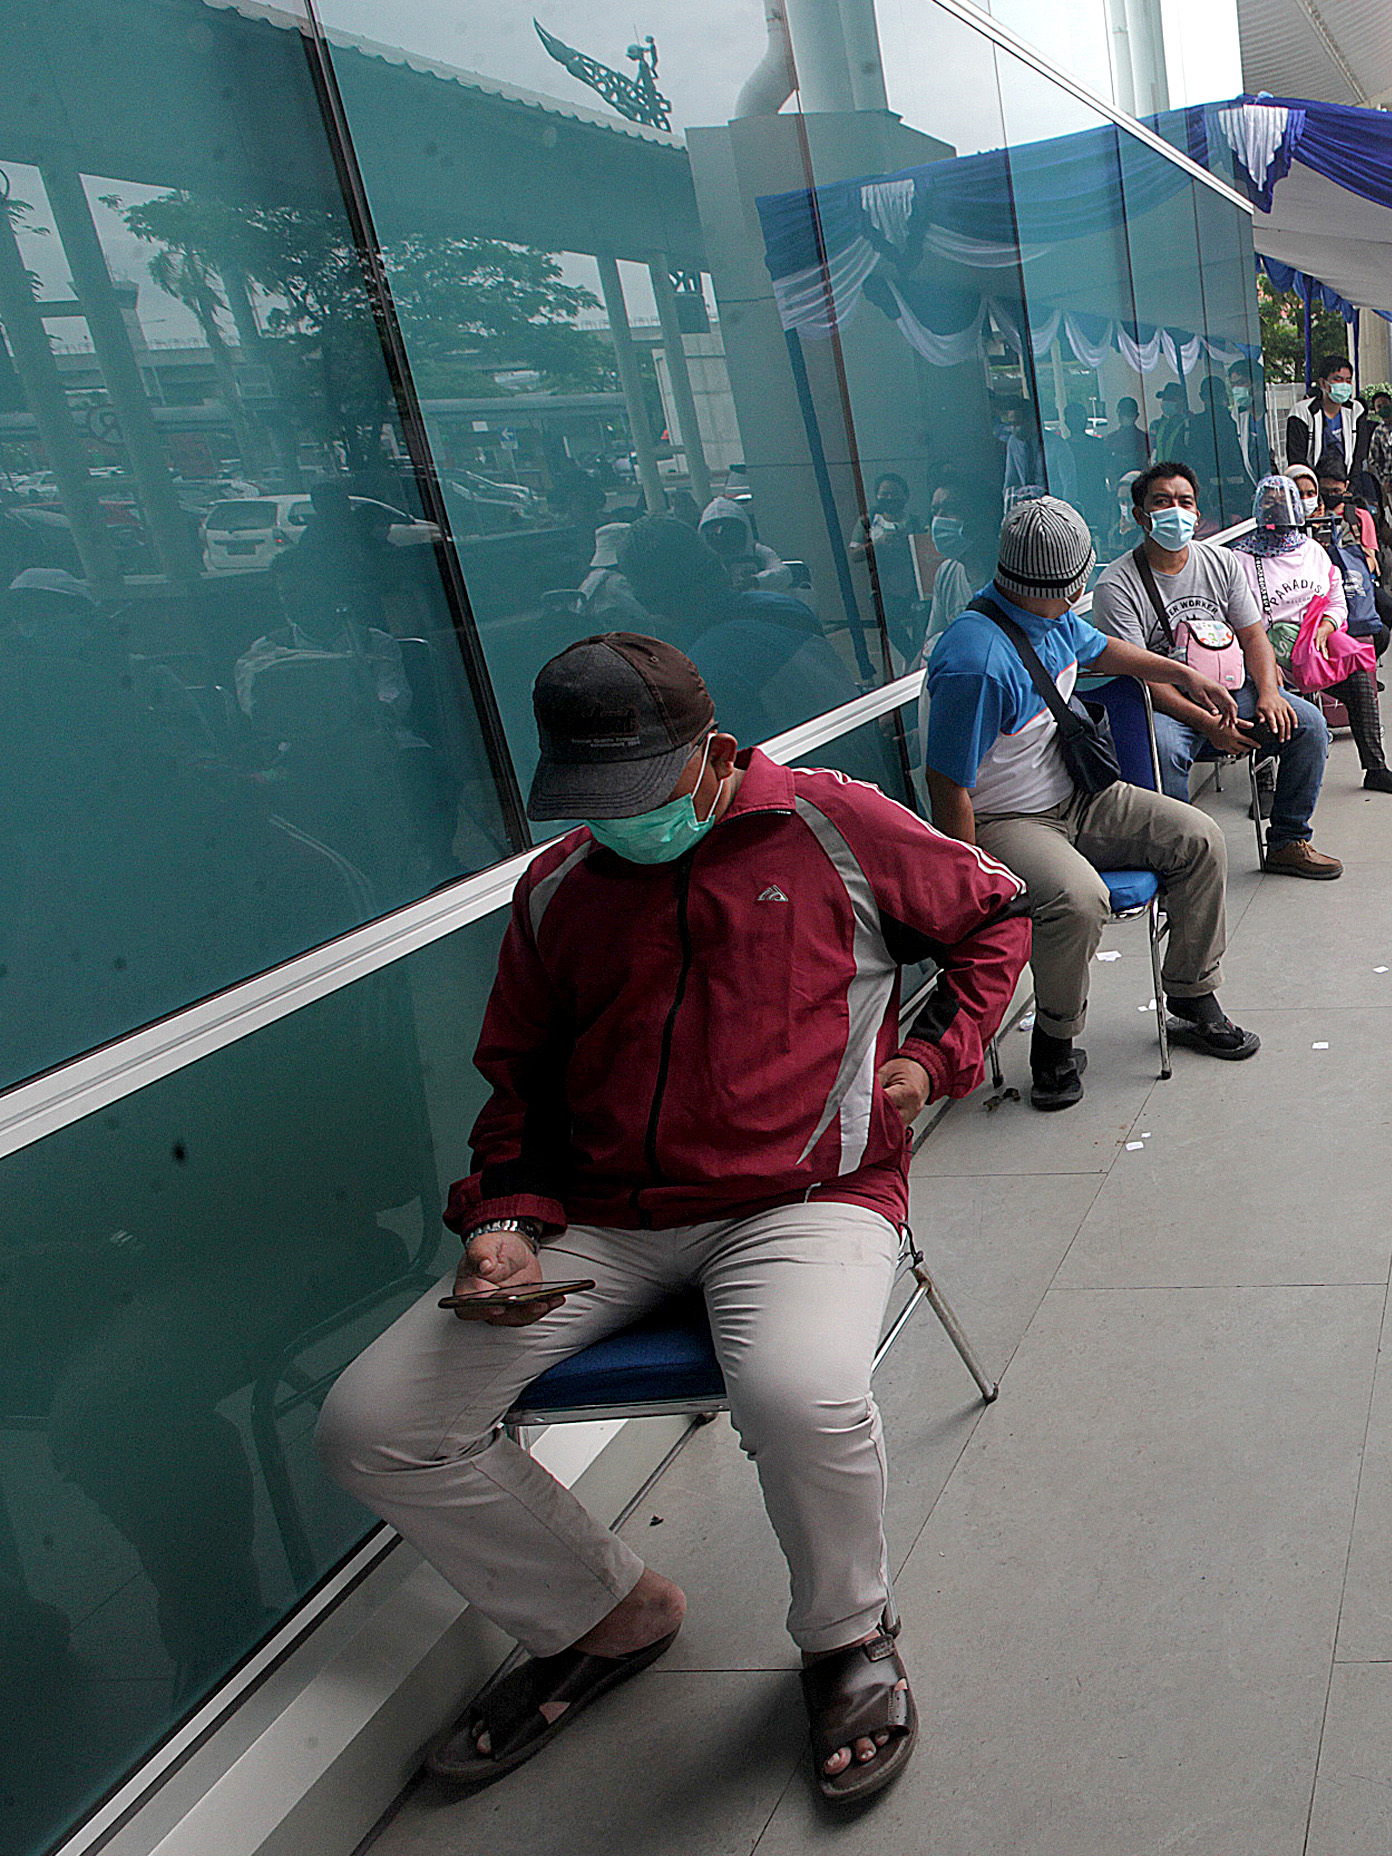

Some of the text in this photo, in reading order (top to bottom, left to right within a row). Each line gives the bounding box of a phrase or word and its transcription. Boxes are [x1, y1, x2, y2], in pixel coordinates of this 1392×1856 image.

[1269, 579, 1325, 606] PARADIS
[1286, 596, 1311, 604] WELCOM
[1180, 599, 1219, 615] WORKER
